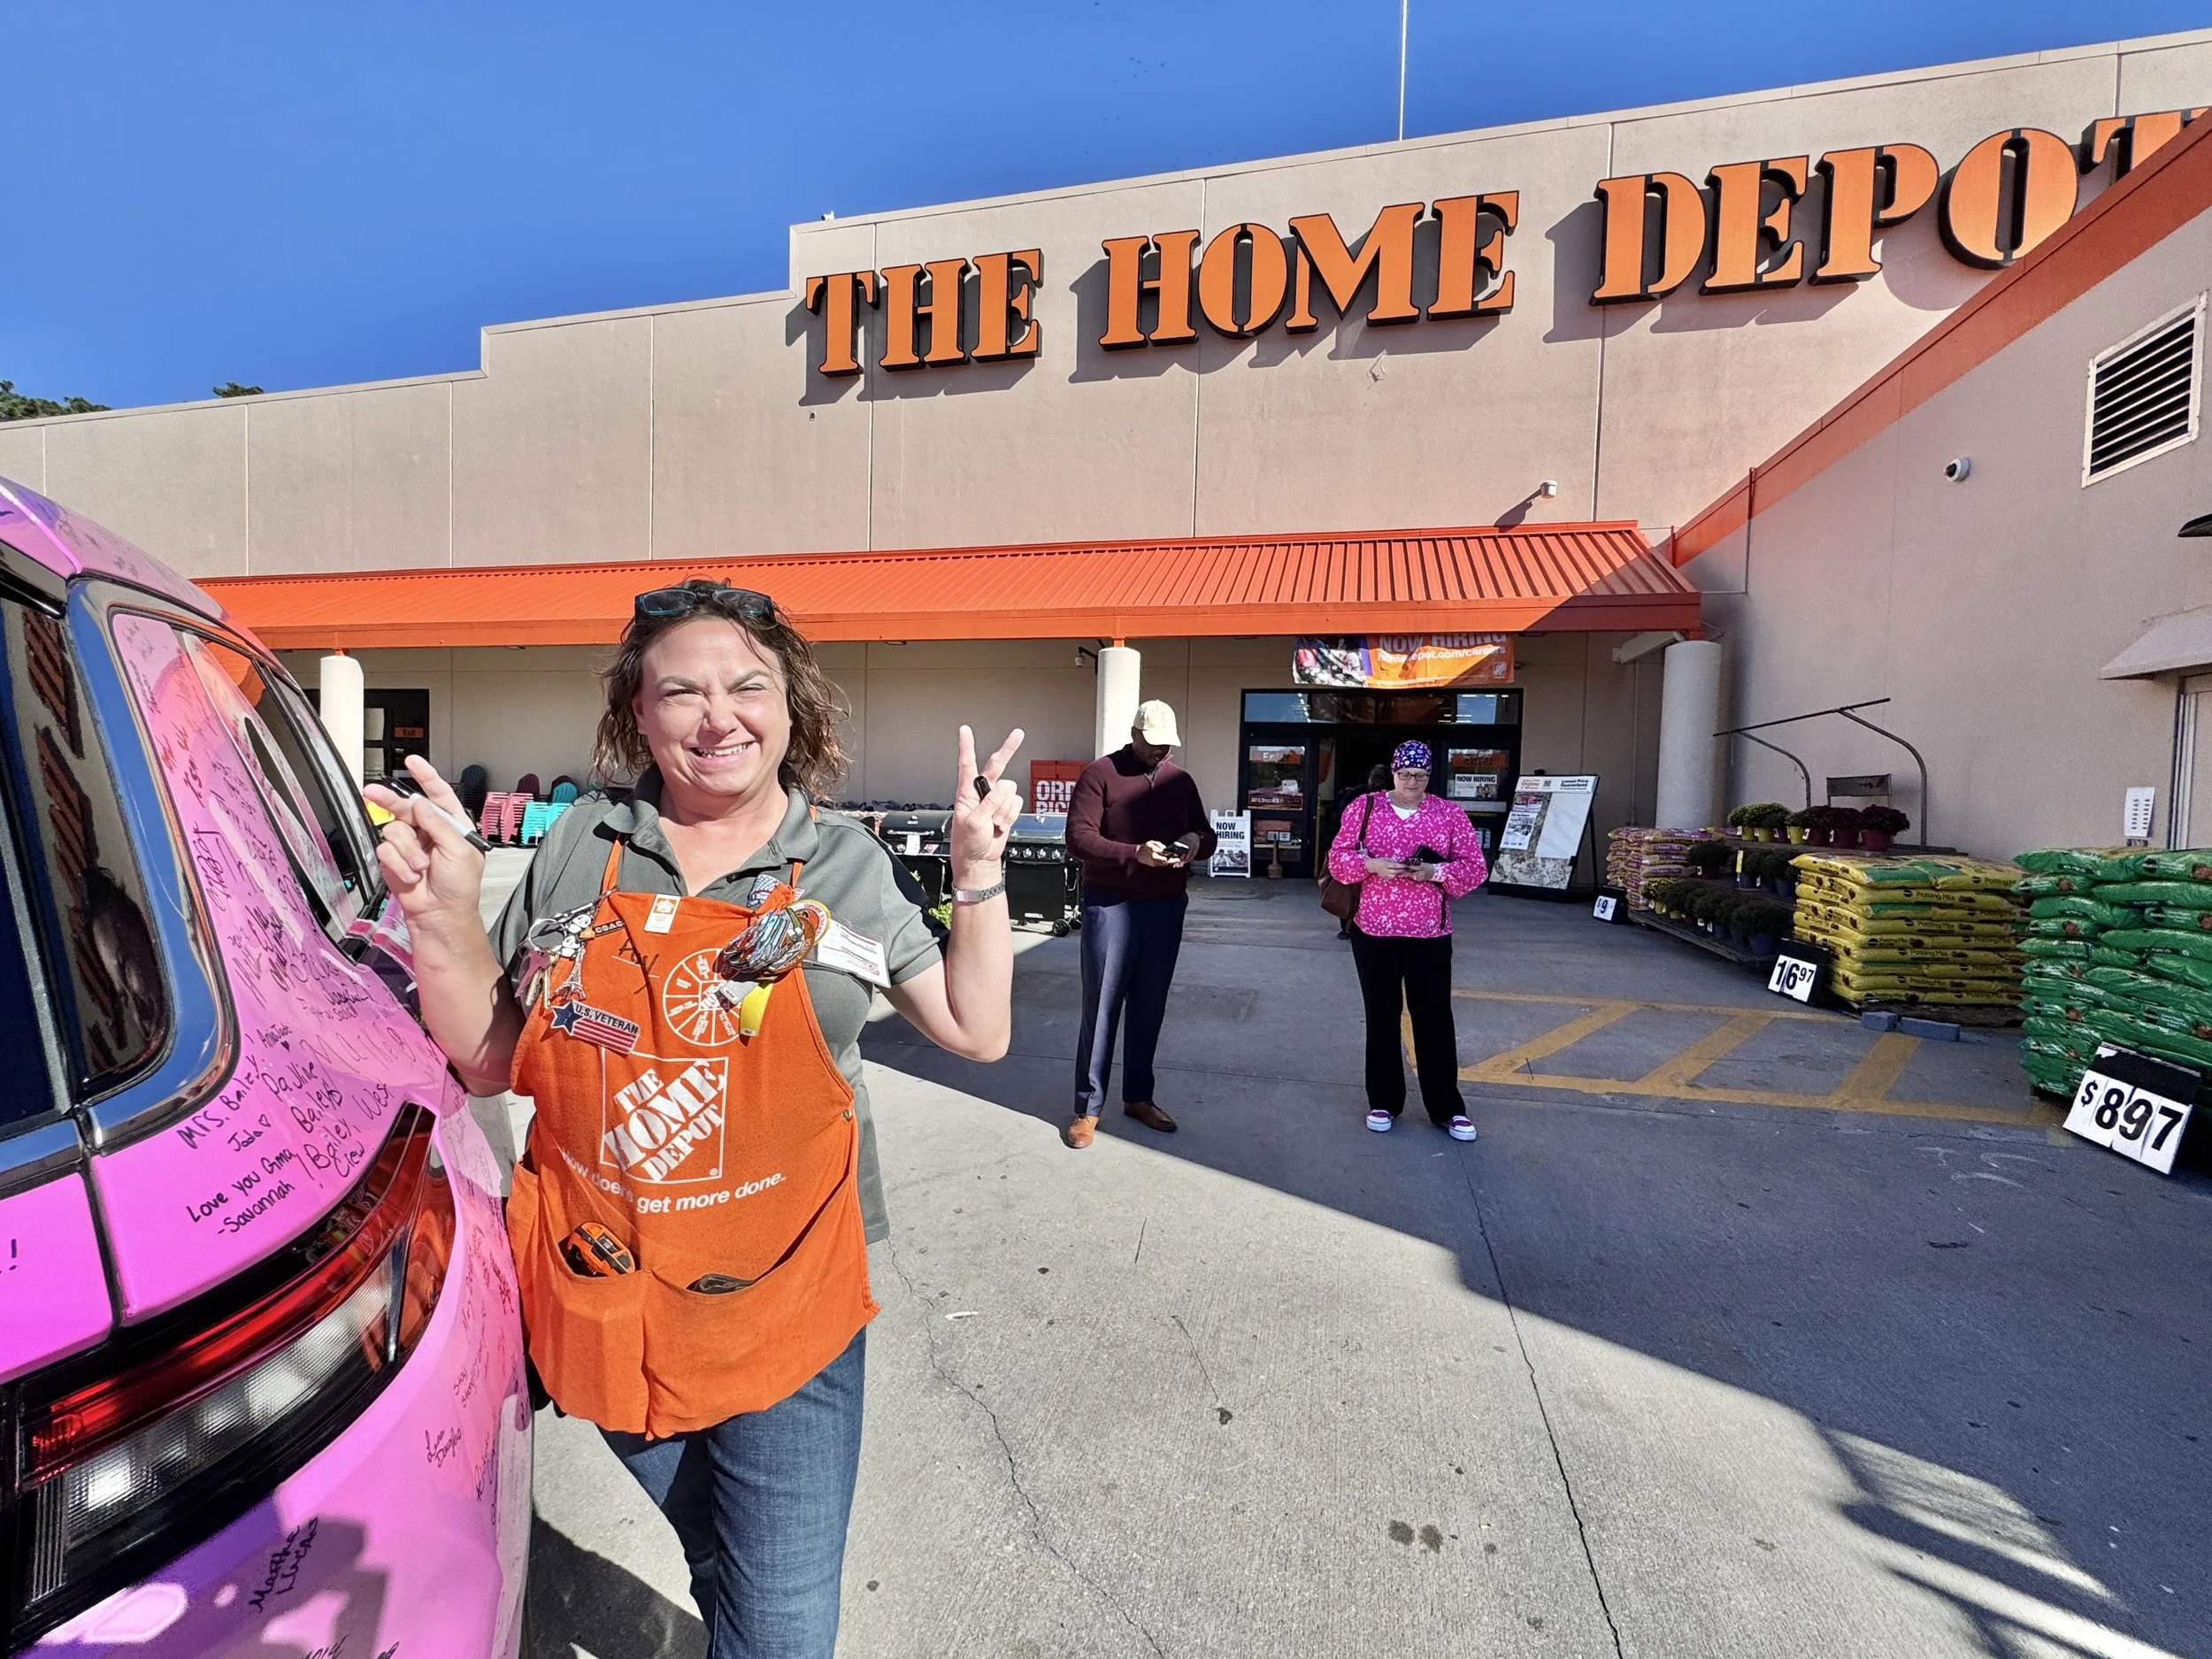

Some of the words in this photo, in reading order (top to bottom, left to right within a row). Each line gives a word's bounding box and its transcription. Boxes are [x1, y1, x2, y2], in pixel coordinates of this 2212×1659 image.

[806, 249, 1043, 378] THE
[1099, 189, 1520, 351] HOME
[1472, 775, 1496, 784] HIRING
[1036, 801, 1070, 814] PIC
[1216, 821, 1236, 831] NOW
[1216, 831, 1245, 841] HIRING
[595, 920, 625, 934] COAC
[574, 1003, 592, 1019] U.S.
[595, 1010, 639, 1034] VETERAN
[613, 1068, 664, 1114] THE
[603, 1060, 726, 1172] HOME
[2080, 1079, 2184, 1151] $897
[641, 1103, 723, 1183] DEPOT
[186, 1192, 229, 1224] Love
[636, 1196, 672, 1215] get
[675, 1190, 730, 1211] more
[734, 1171, 787, 1200] done.
